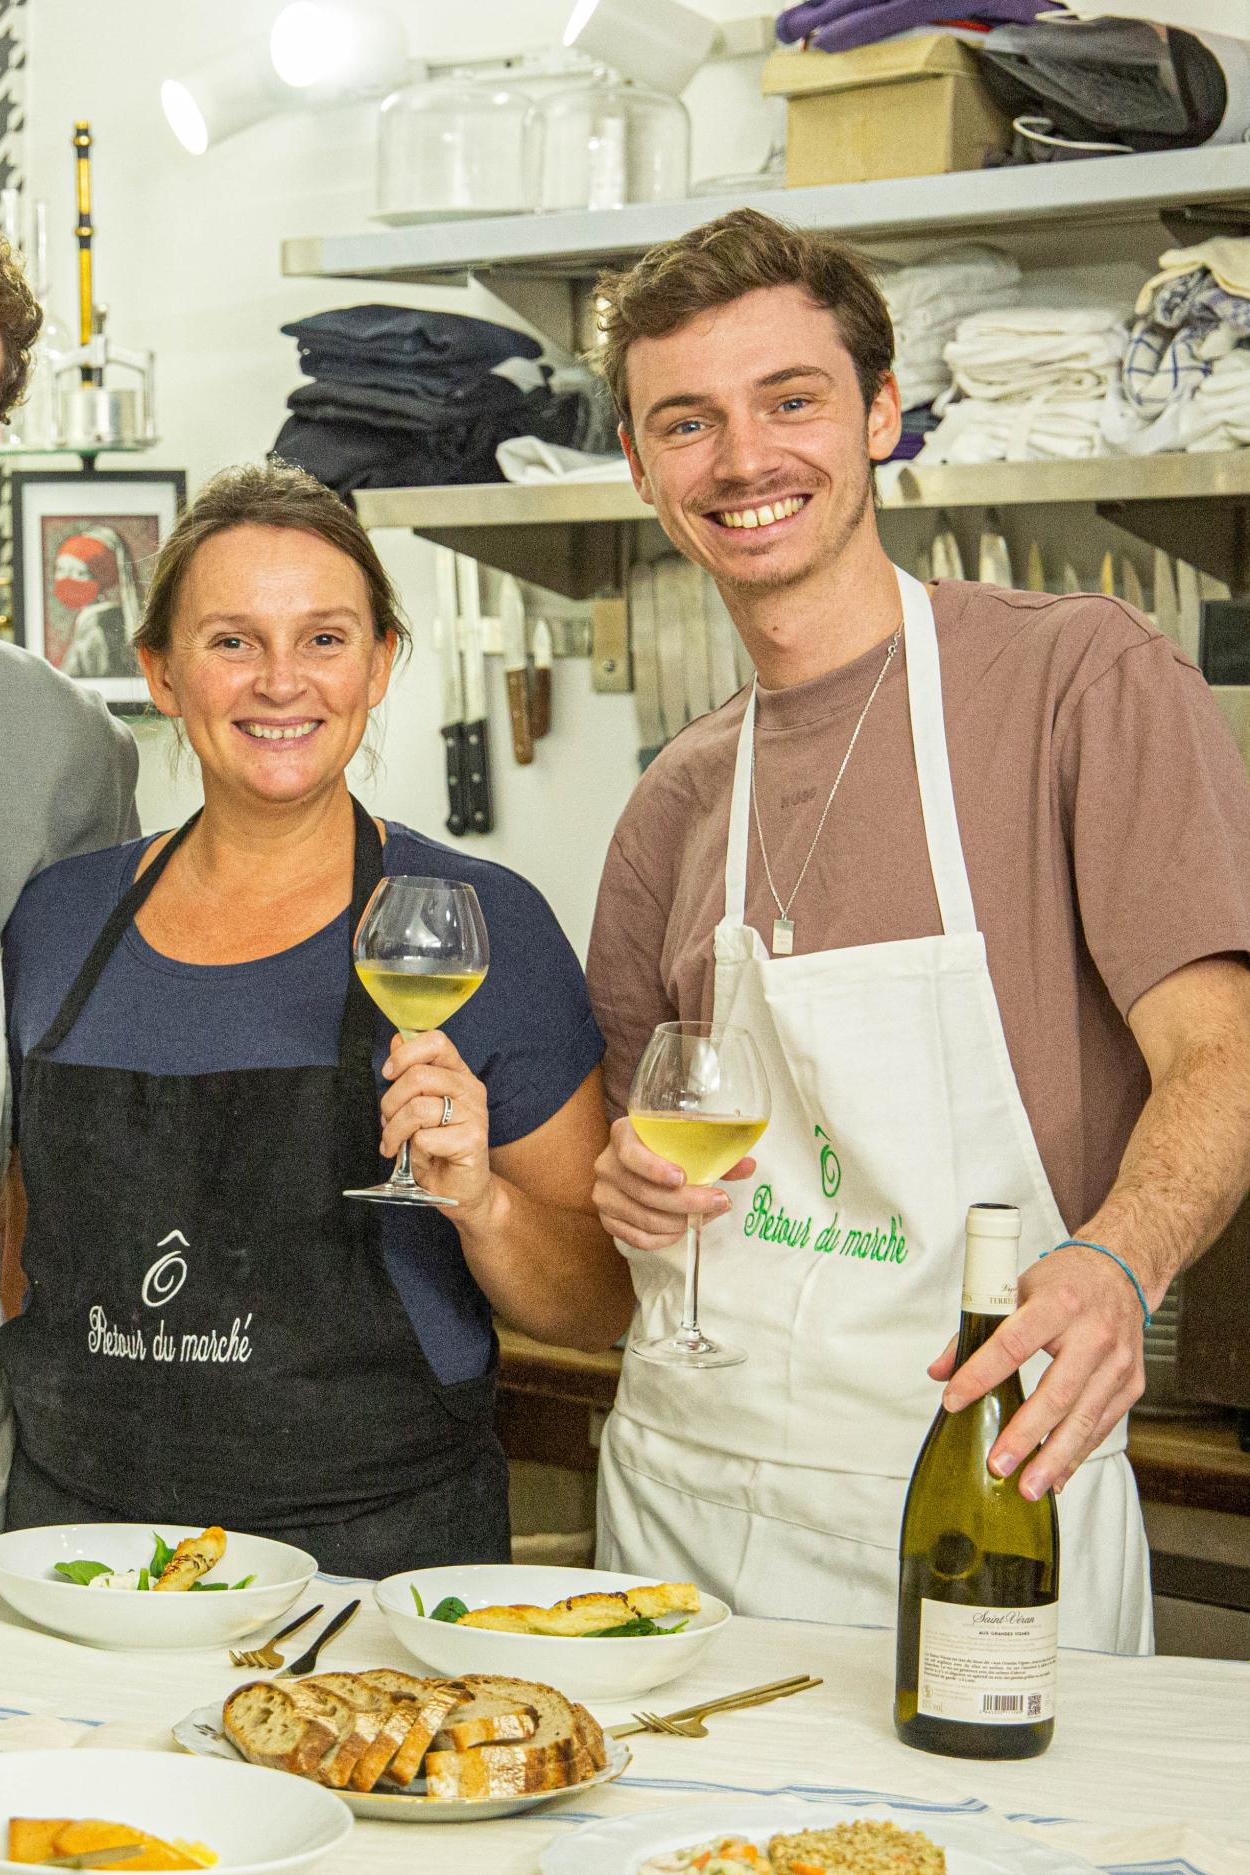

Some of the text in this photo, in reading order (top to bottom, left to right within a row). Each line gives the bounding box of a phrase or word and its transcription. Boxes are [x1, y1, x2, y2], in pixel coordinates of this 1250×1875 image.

[743, 1183, 813, 1249] Retour
[813, 1211, 842, 1253] du
[87, 1305, 253, 1363] Retour du marché
